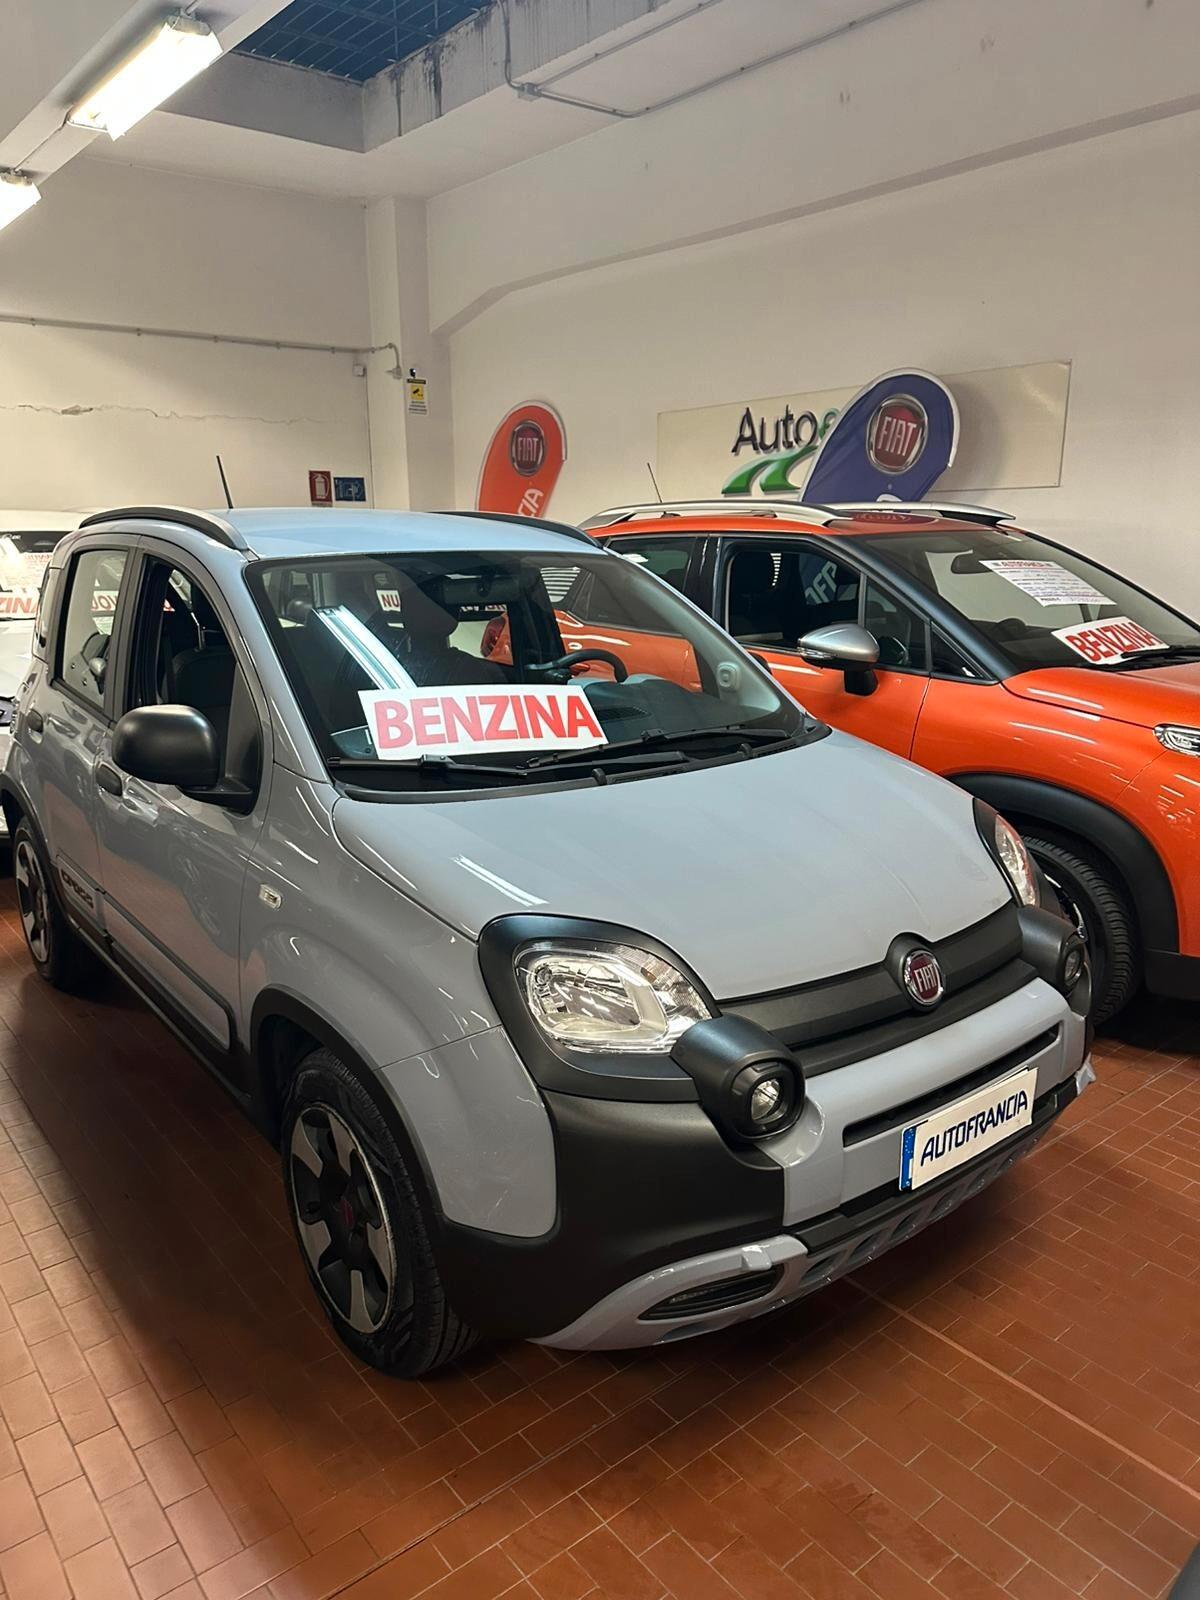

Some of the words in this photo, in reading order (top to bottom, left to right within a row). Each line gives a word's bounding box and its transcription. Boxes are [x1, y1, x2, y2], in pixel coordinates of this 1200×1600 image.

[517, 437, 539, 461] FIAT
[878, 415, 917, 457] FIAT
[1065, 622, 1163, 662] BENZINA
[374, 694, 604, 750] BENZINA
[913, 963, 937, 993] FIAT
[921, 1090, 1028, 1167] AUTOFRANCIA
